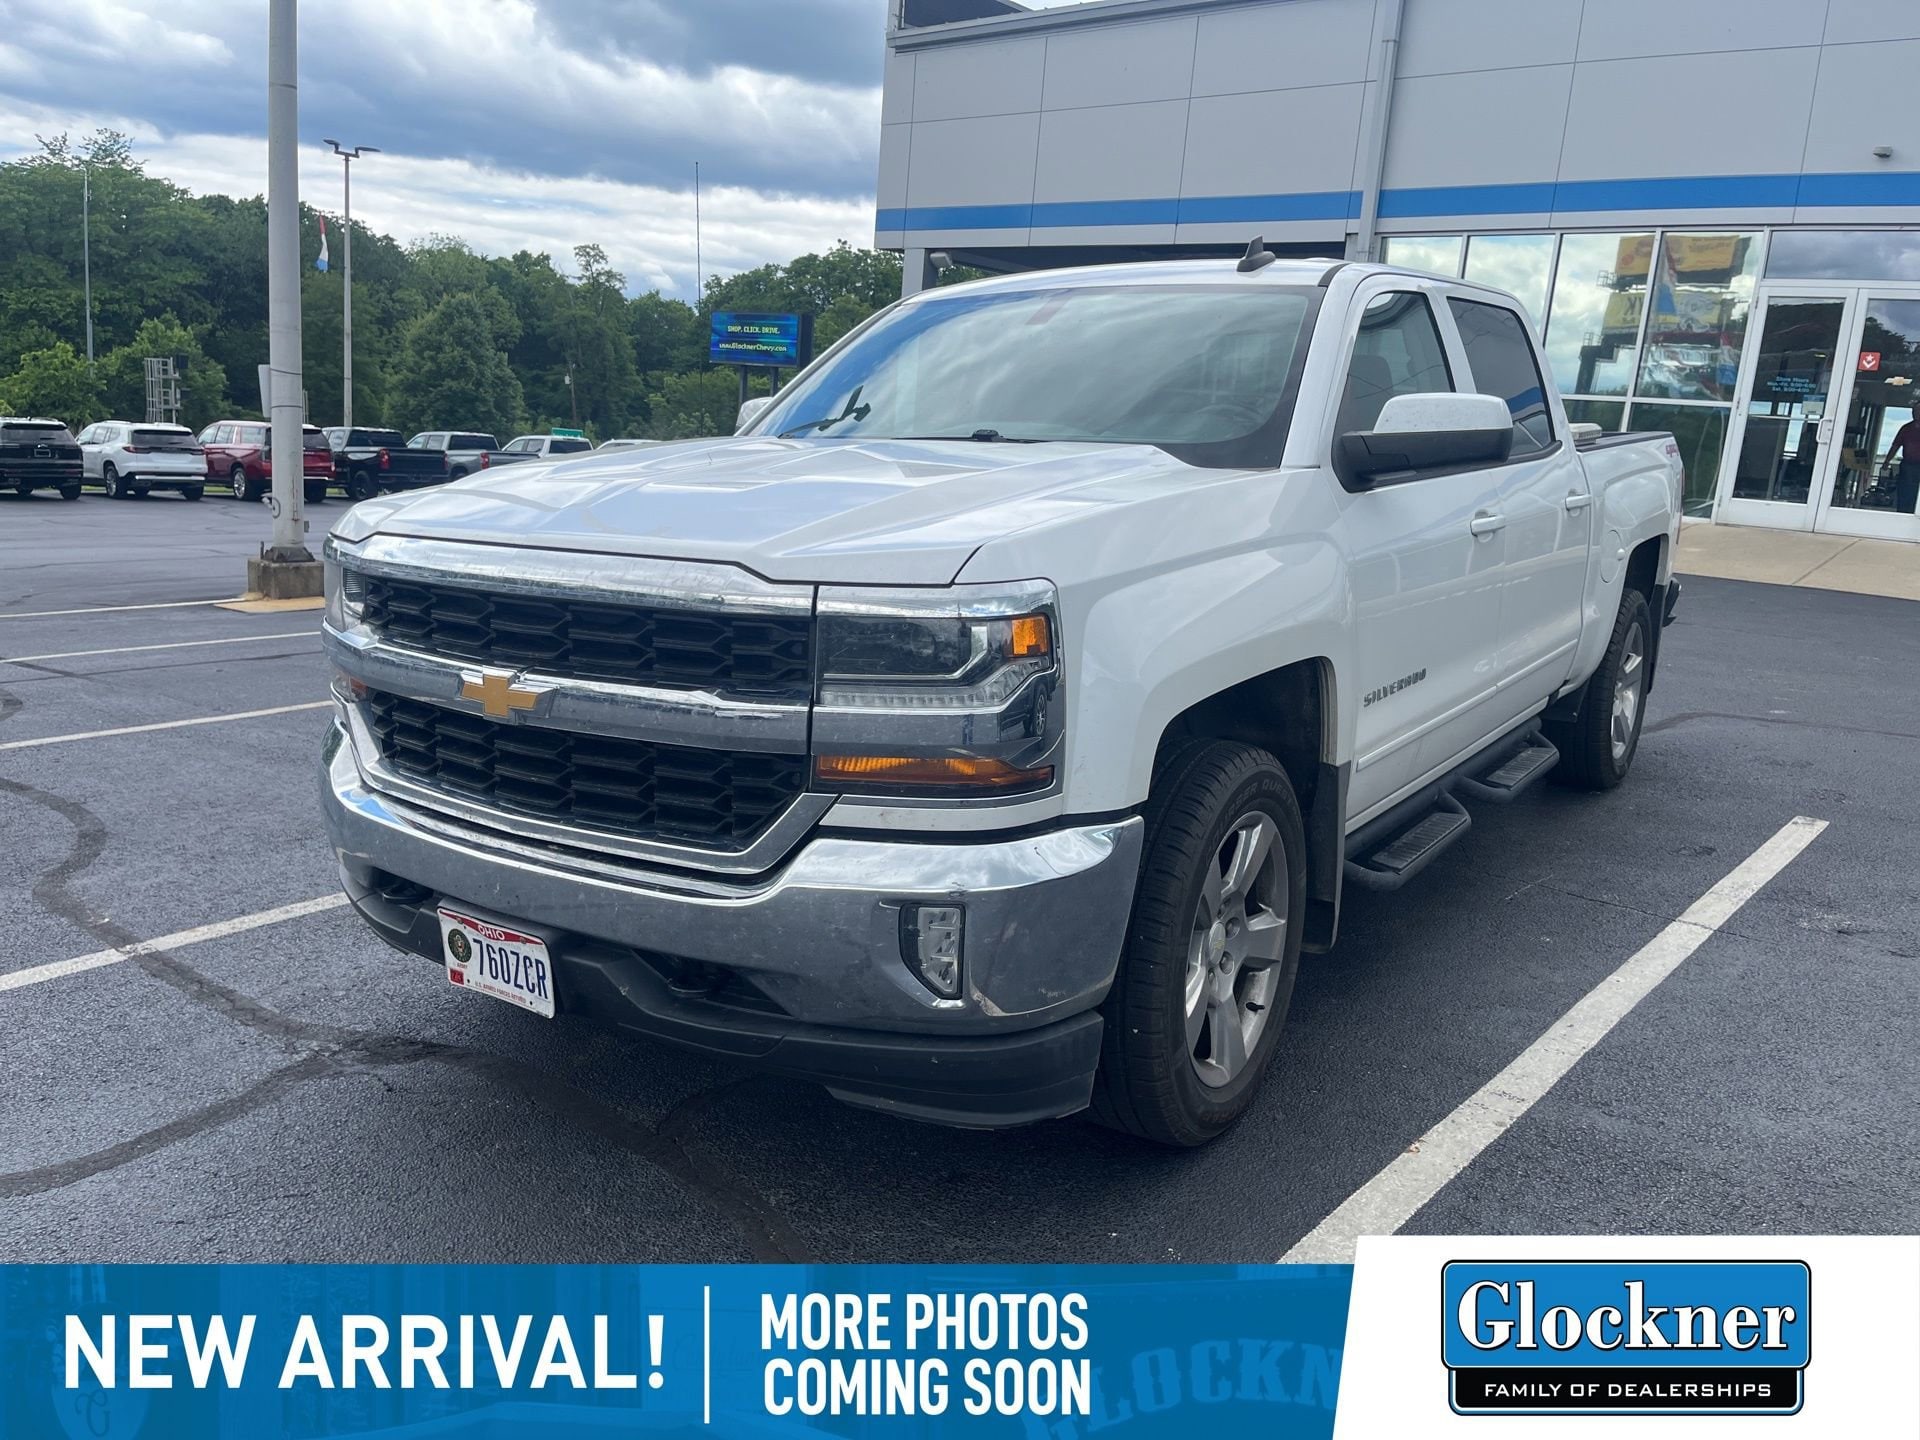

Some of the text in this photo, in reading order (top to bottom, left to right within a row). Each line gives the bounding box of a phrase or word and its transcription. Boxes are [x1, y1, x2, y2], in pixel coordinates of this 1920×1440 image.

[1363, 667, 1427, 708] SILVERADO
[477, 924, 505, 941] OHIO
[472, 937, 549, 1000] 760ZCR
